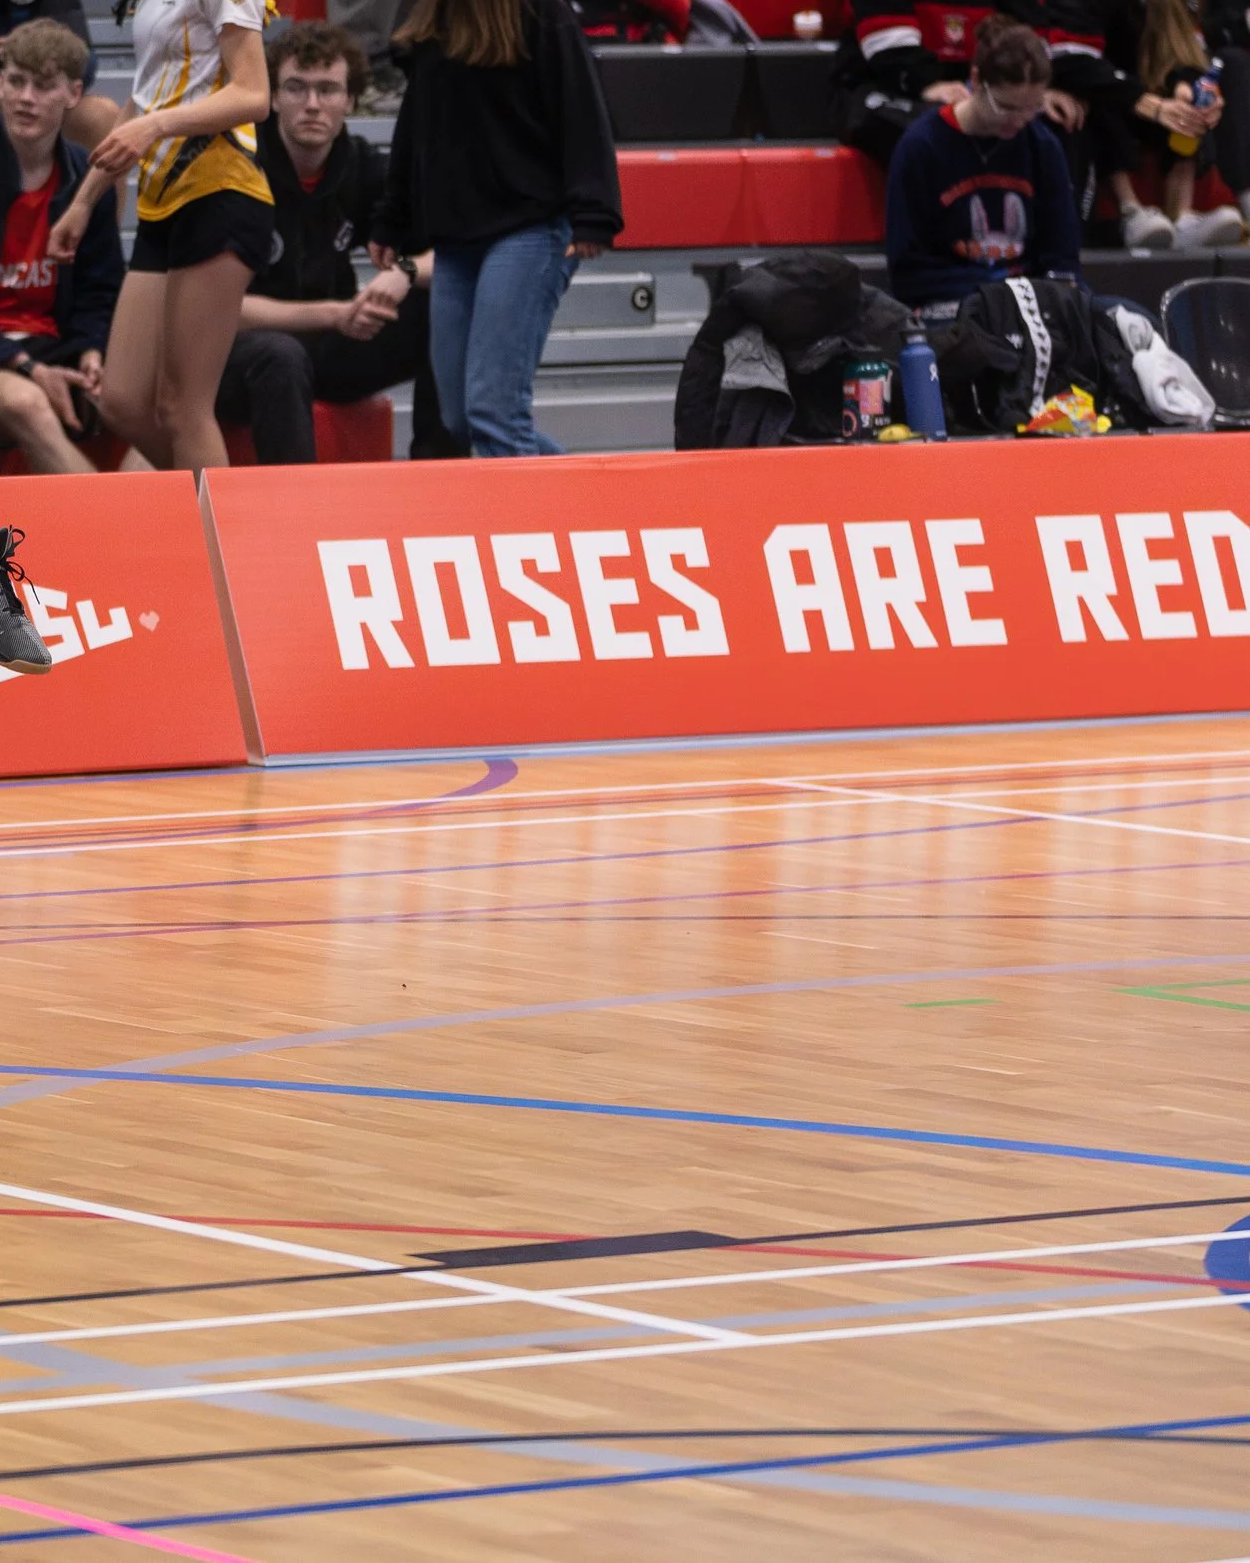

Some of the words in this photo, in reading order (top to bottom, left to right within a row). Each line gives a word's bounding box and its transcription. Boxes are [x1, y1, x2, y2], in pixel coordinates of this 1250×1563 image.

[316, 526, 730, 670] ROSES
[762, 518, 1009, 654] ARE
[1034, 510, 1250, 643] RED
